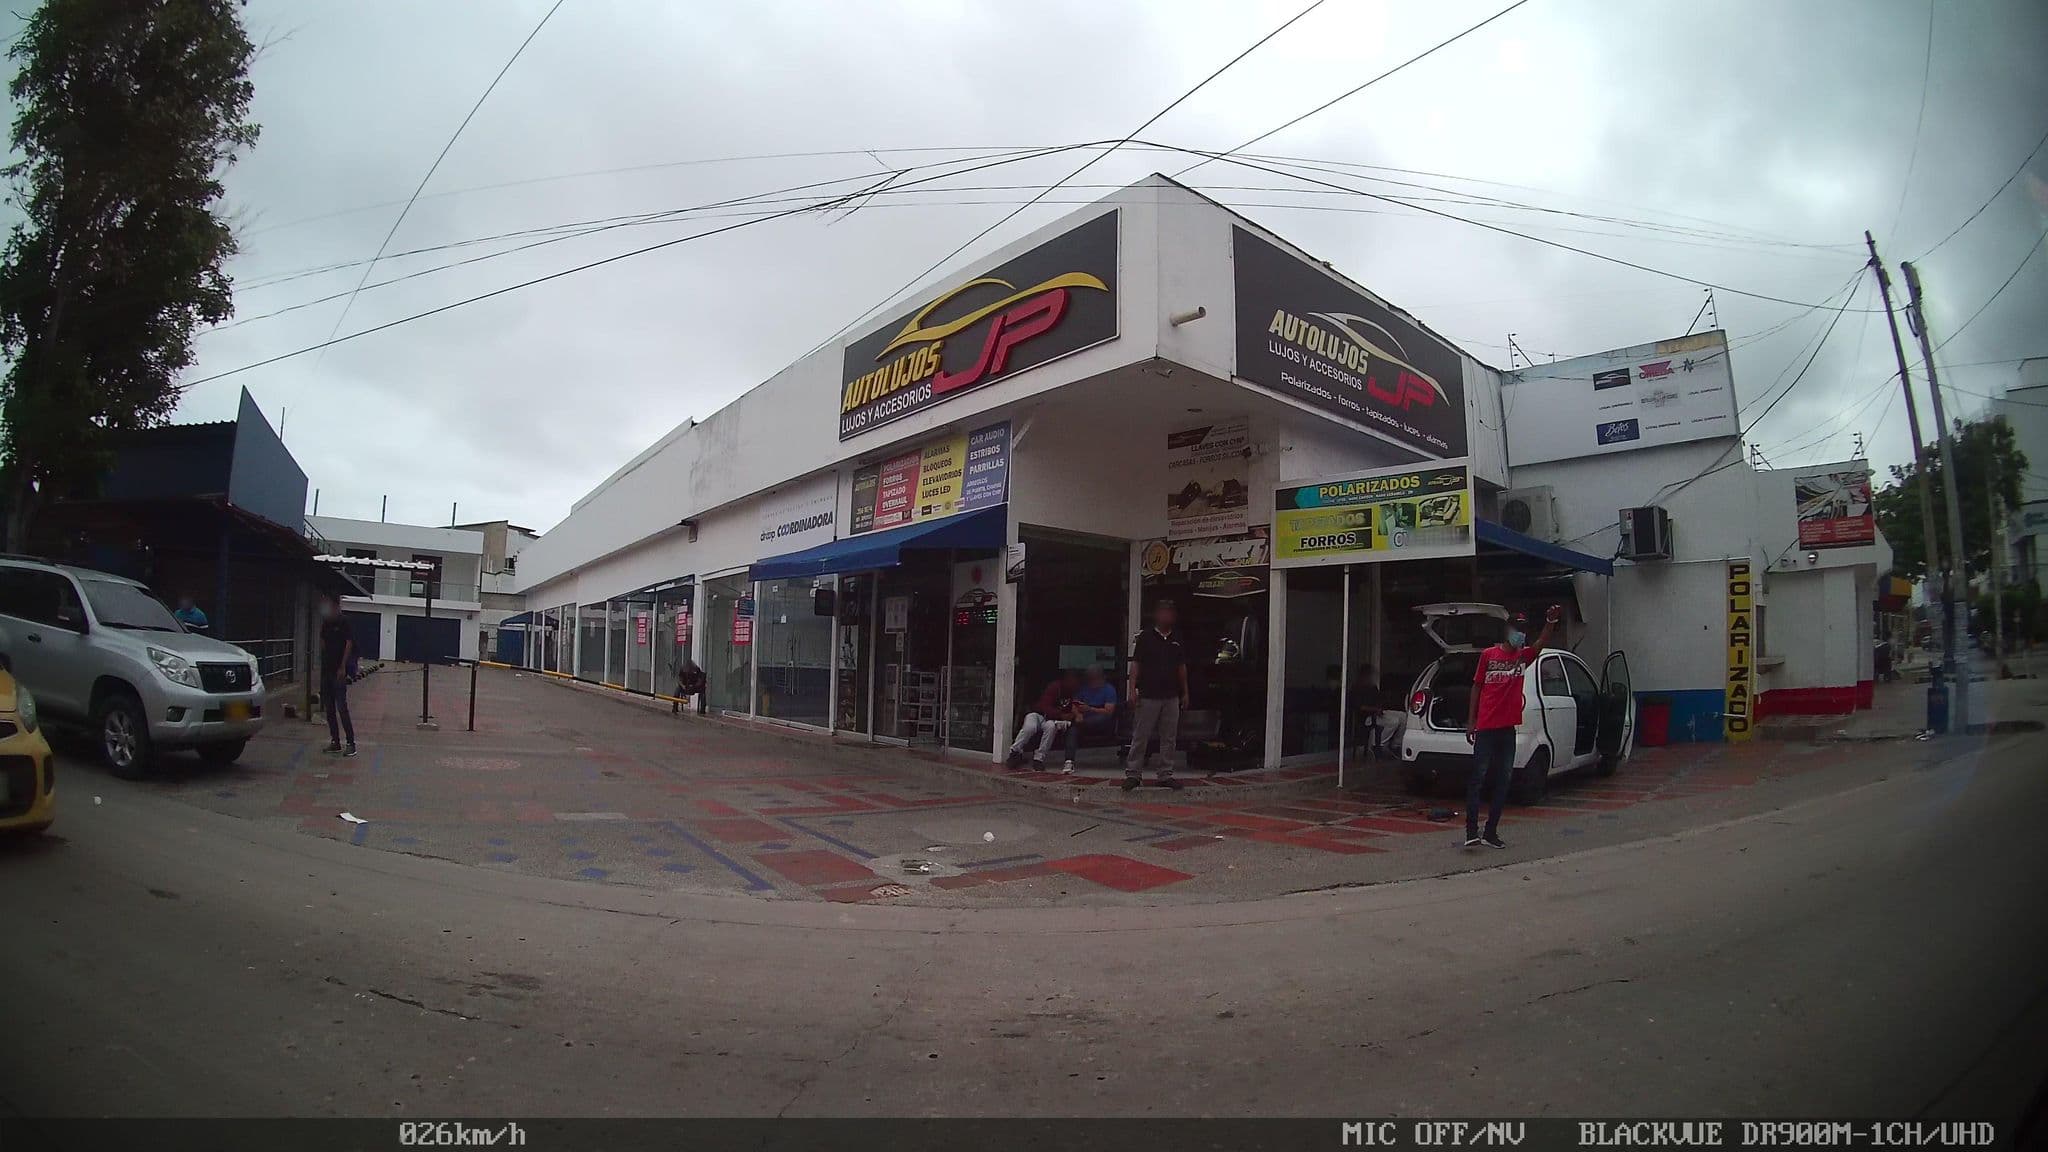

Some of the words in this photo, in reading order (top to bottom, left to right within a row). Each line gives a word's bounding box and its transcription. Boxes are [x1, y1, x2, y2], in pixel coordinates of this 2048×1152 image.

[932, 288, 1071, 395] JP
[1268, 309, 1370, 376] AUTOLUJOS
[841, 340, 945, 414] AUTOLUJOS
[1269, 340, 1301, 365] LUJOS
[1301, 353, 1309, 367] Y
[1309, 359, 1363, 392] ACCESORIOS
[1281, 371, 1333, 401] Polarizados
[1338, 394, 1362, 412] forros
[1366, 406, 1400, 428] tapizados
[1367, 370, 1435, 412] JP
[841, 412, 867, 434] LUJOS
[866, 407, 875, 424] Y
[873, 383, 932, 421] ACCESORIOS
[970, 434, 984, 446] CAR
[984, 428, 1005, 443] AUDIO
[924, 445, 950, 460] ALARMAS
[970, 445, 1001, 461] ESTRIBOS
[922, 469, 962, 487] ELEVAVIDRIOS
[923, 458, 952, 473] BLOQUEOS
[969, 458, 1005, 475] PARRILLAS
[922, 488, 939, 499] LUCES
[940, 485, 951, 495] LED
[1319, 475, 1421, 499] POLARIZADOS
[777, 511, 834, 538] COORDINADORA
[1300, 532, 1357, 548] FORROS
[1728, 565, 1751, 733] POLARIZADO
